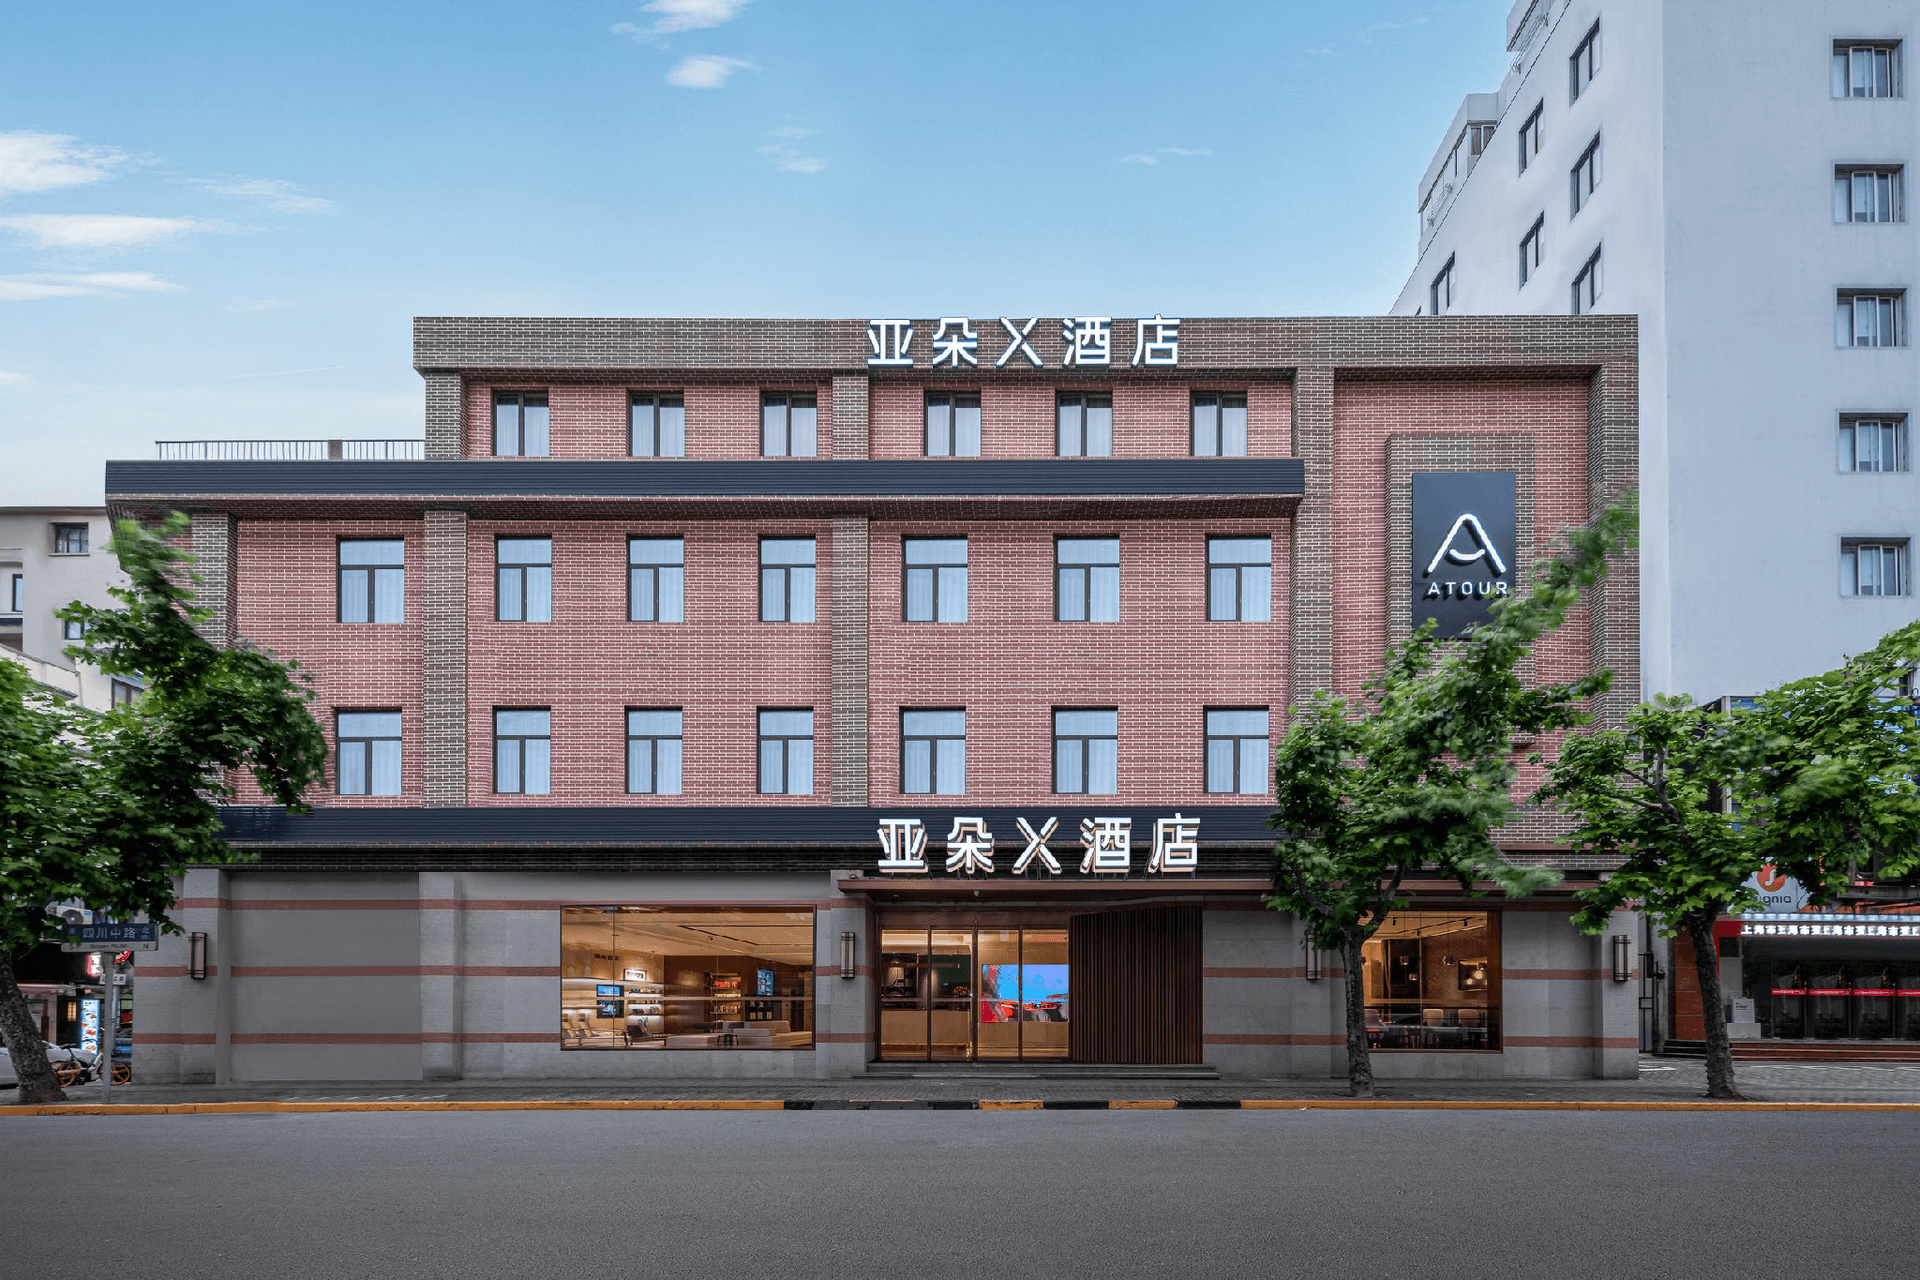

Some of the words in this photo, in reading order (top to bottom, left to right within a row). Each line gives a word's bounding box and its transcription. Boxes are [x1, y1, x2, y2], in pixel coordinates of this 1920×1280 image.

[1427, 581, 1508, 595] ATOUR
[1755, 895, 1792, 906] ignia
[83, 927, 136, 939] 四川中路
